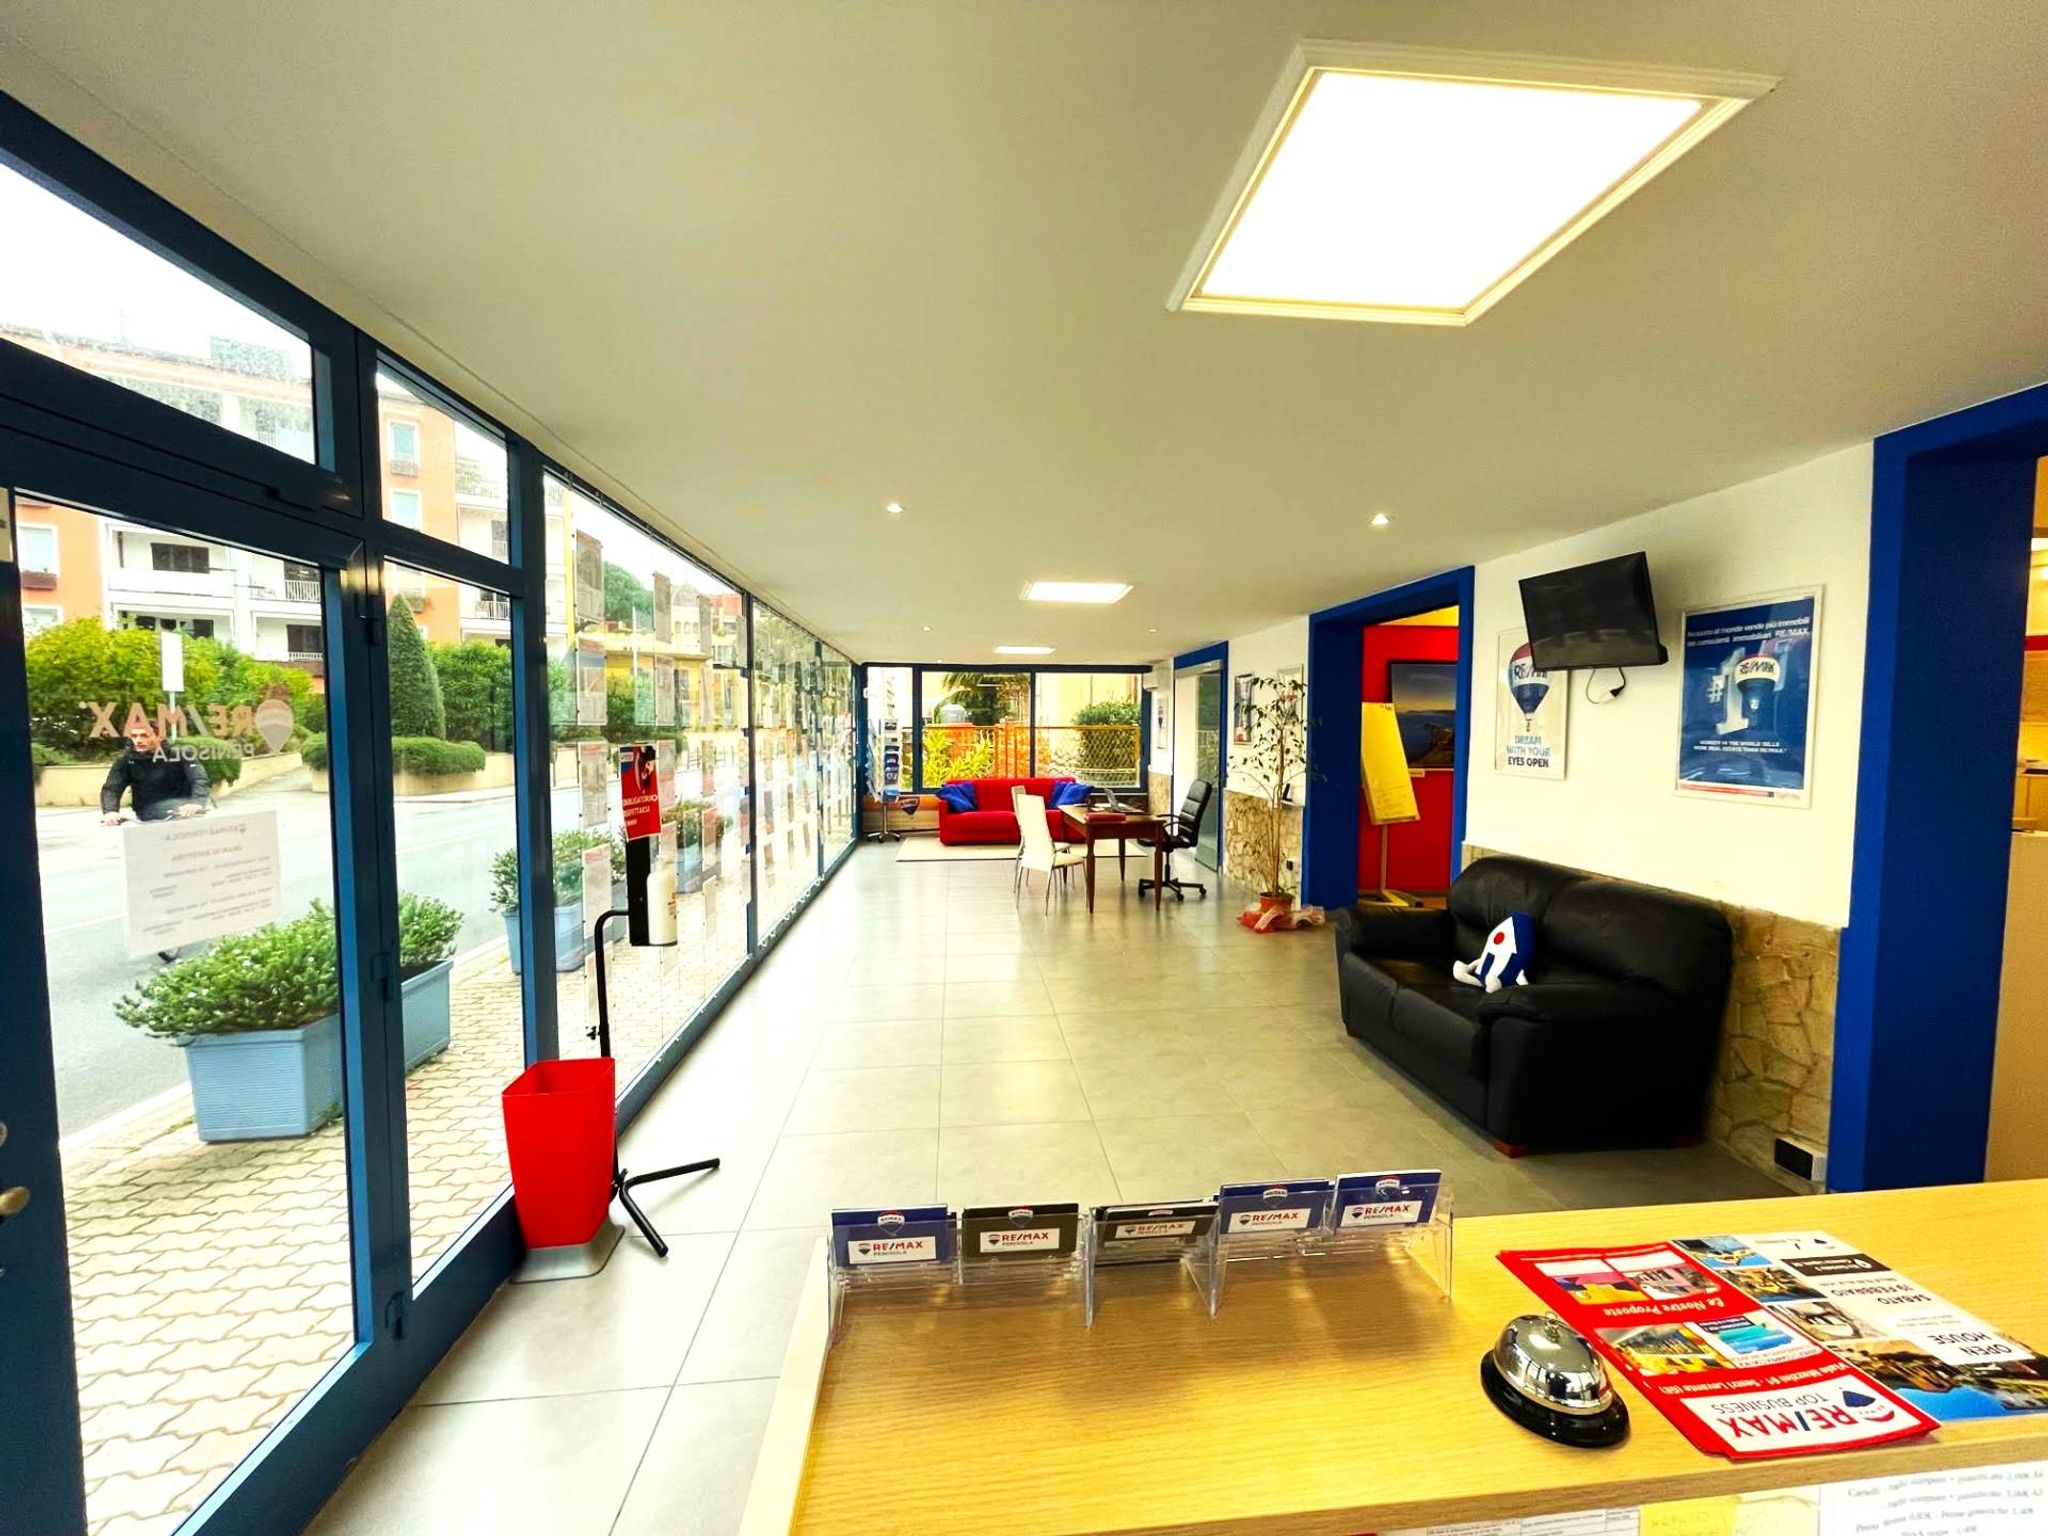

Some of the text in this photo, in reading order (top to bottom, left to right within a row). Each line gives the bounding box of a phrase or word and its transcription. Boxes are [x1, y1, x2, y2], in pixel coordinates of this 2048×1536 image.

[1514, 735, 1542, 745] DREAM
[1506, 745, 1551, 757] WITH YOUR
[1508, 756, 1549, 768] EYES OPEN
[1365, 1204, 1411, 1214] RE/MAX
[1252, 1212, 1299, 1222] RE/MAX
[1001, 1231, 1049, 1242] RE/MAX
[872, 1240, 924, 1251] RE/MAX
[1831, 1286, 1898, 1297] FEBBRAIO
[1877, 1294, 1932, 1305] SABATO
[1603, 1297, 1725, 1316] Le Nostre Proposte
[1927, 1331, 1992, 1345] HOUSE
[1959, 1343, 2012, 1356] OPEN
[1822, 1361, 1850, 1374] Viale
[1780, 1369, 1822, 1382] Mazzini
[1684, 1381, 1729, 1392] Levante
[1711, 1392, 1830, 1415] TOP BUSINESS
[1717, 1404, 1860, 1438] RE/MAX
